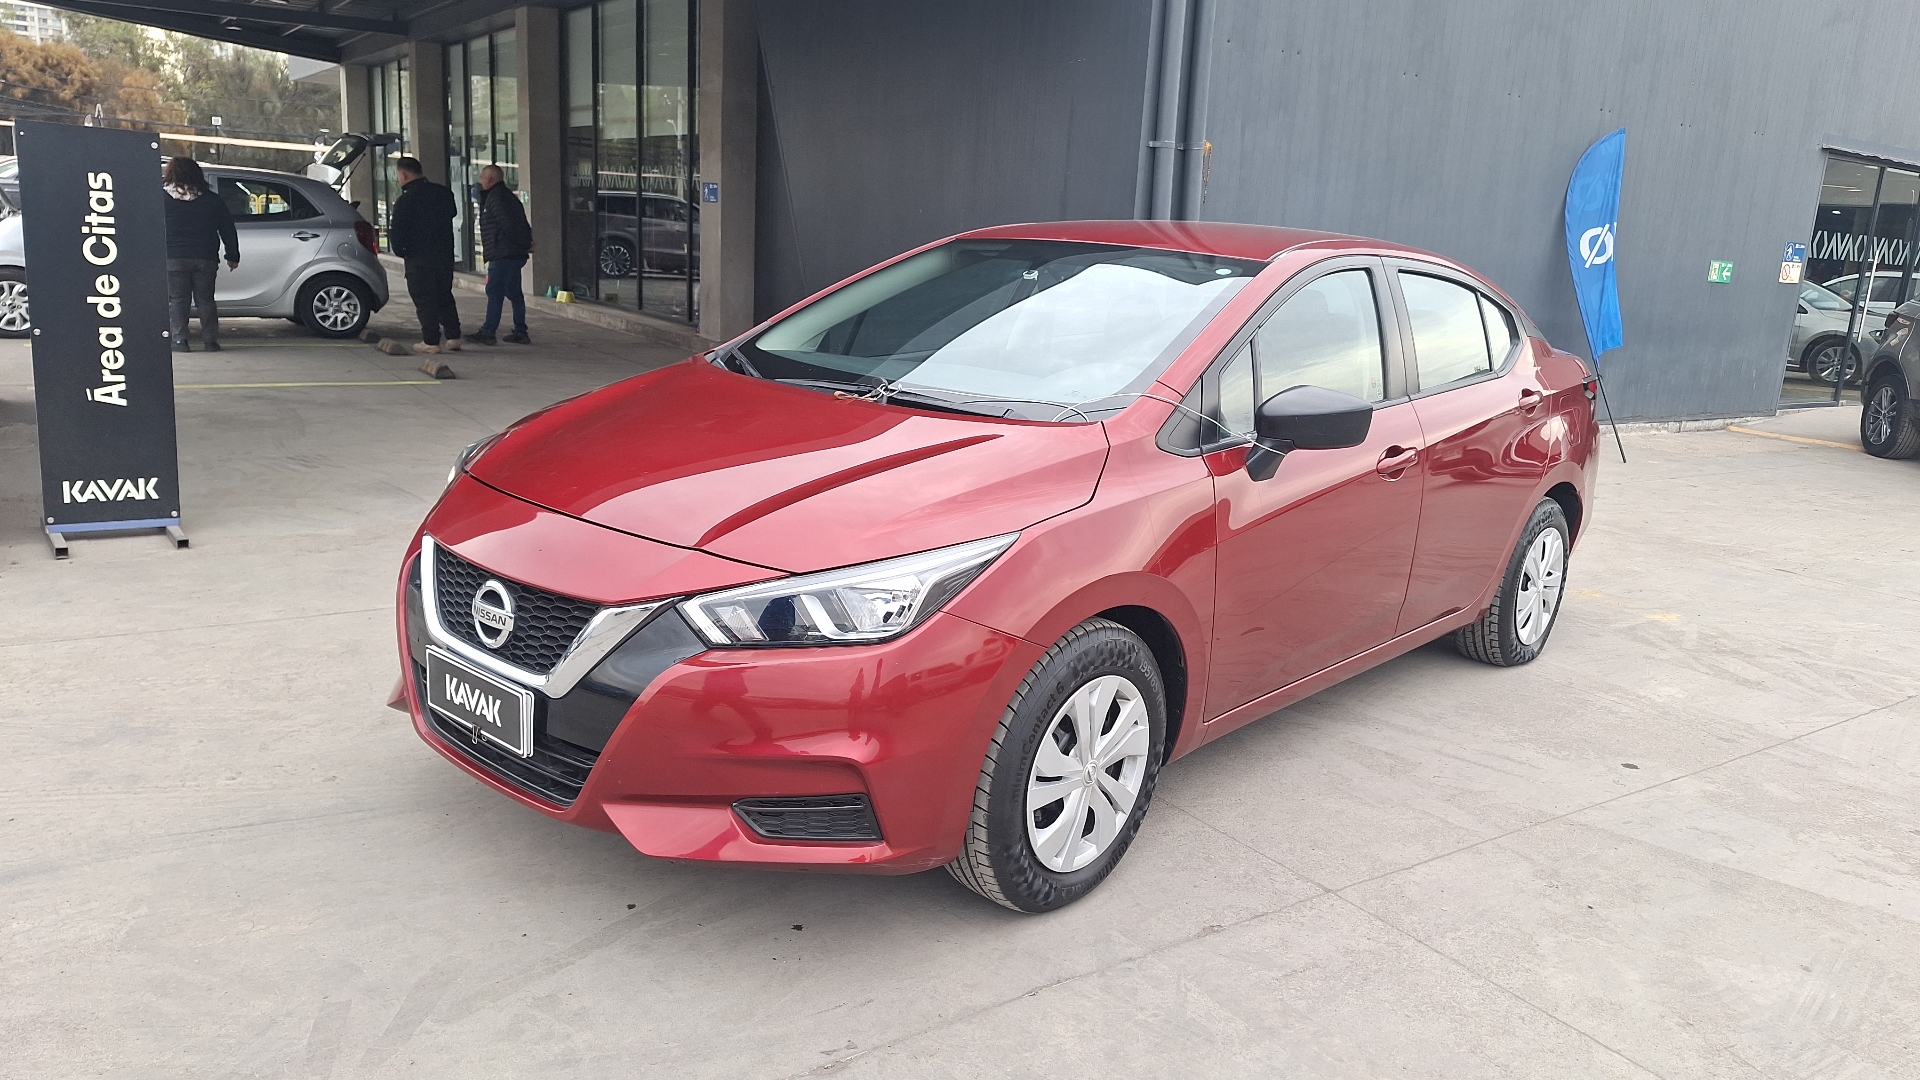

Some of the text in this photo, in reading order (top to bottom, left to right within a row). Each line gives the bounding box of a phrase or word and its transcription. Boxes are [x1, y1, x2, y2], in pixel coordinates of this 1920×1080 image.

[82, 171, 127, 406] Área de Citas
[62, 477, 159, 504] KAVAK
[475, 605, 507, 627] NISSAN
[445, 673, 502, 728] KAVAK
